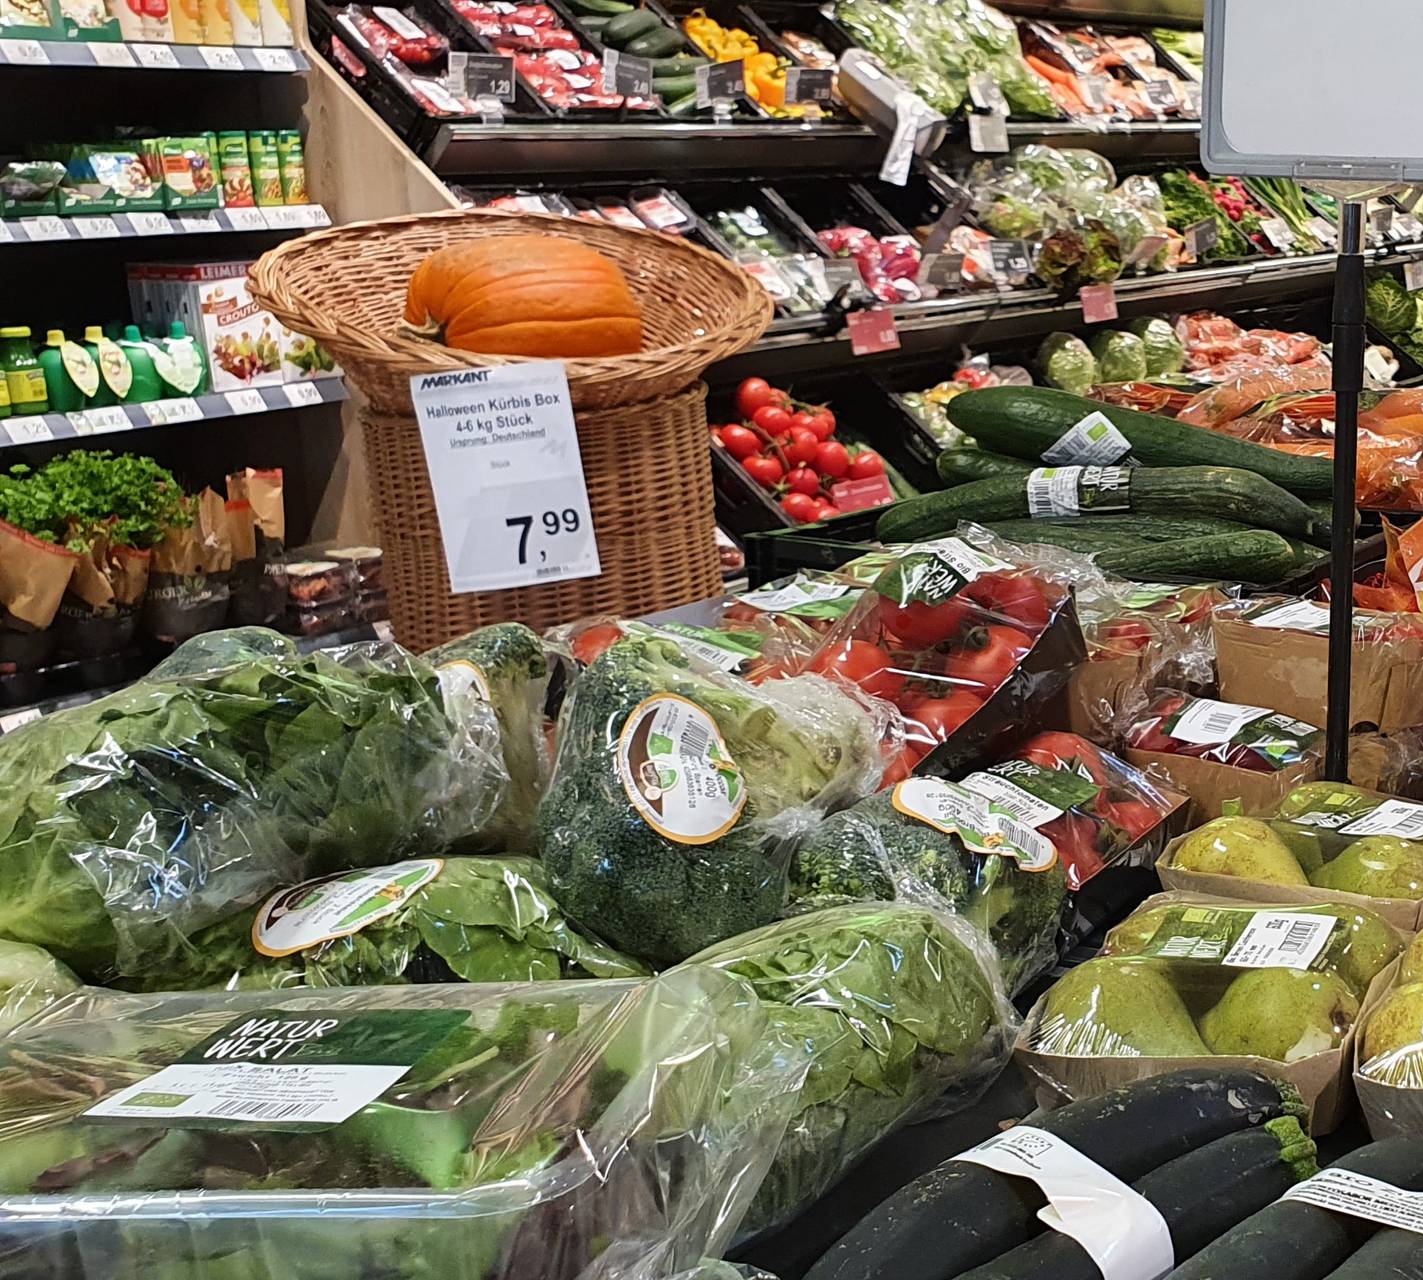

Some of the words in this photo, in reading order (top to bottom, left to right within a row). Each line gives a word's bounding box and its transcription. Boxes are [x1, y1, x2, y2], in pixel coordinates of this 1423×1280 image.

[200, 263, 247, 281] LEIMER
[219, 303, 260, 325] CROUTO
[420, 370, 492, 391] MARKANT
[426, 403, 486, 419] Halloween
[488, 396, 531, 411] Kürbis
[535, 393, 561, 405] Box
[456, 419, 474, 433] 4-6
[476, 417, 493, 432] kg
[497, 413, 534, 429] Stück
[506, 508, 580, 565] 7,99
[230, 1018, 339, 1039] NATUR
[203, 1037, 305, 1059] WERT
